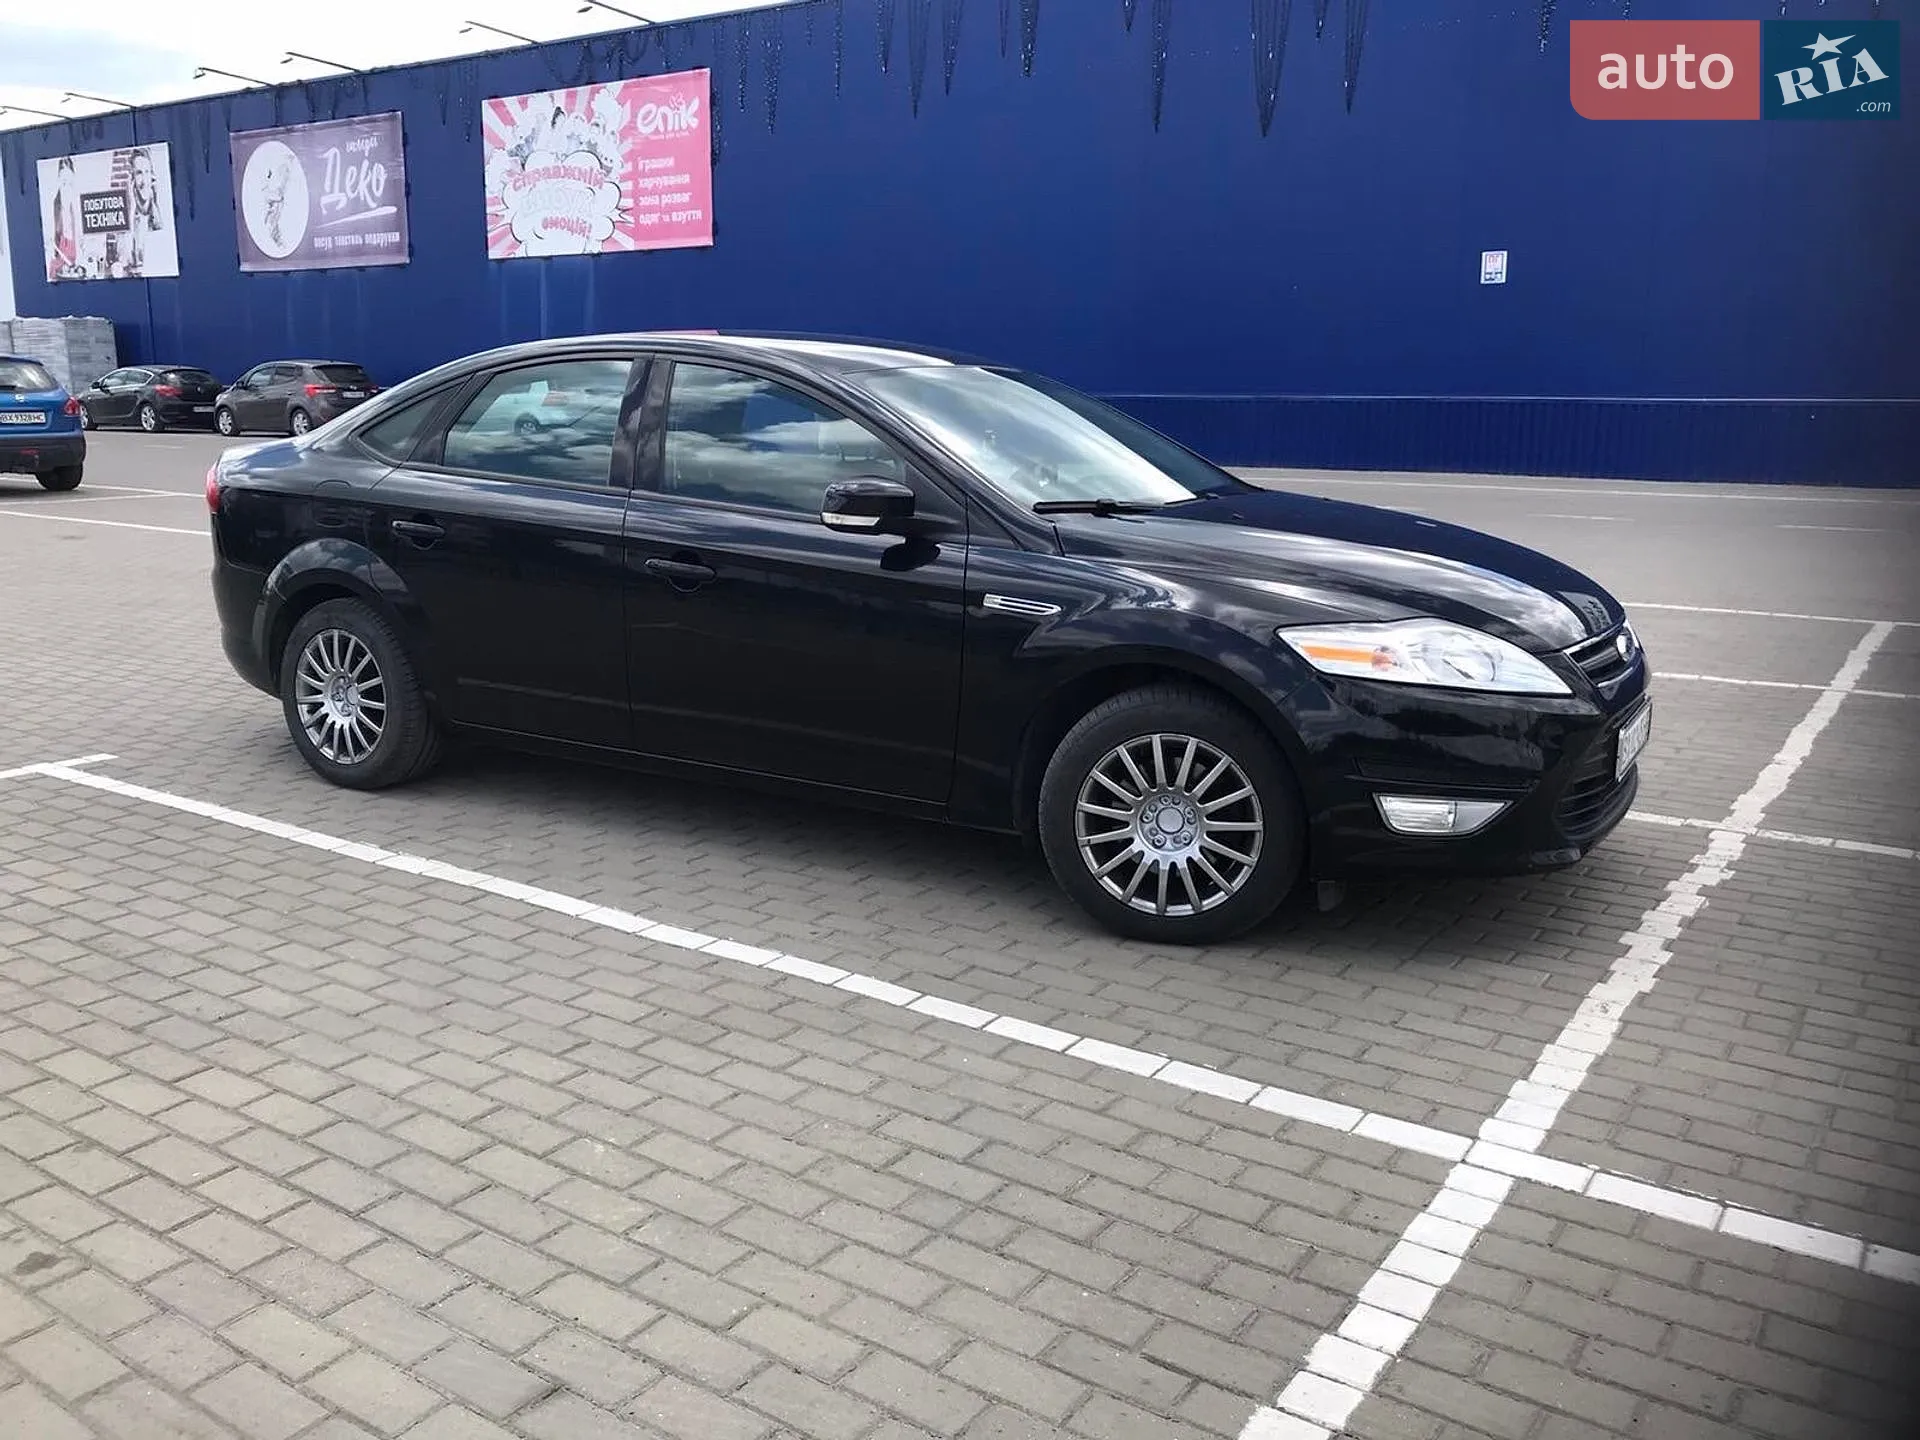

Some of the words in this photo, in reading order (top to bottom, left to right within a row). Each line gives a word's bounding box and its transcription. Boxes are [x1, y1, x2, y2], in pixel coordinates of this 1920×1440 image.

[318, 147, 387, 215] Деко
[83, 196, 124, 211] ПОБУТОВА
[85, 211, 125, 228] ТЕХНІКА
